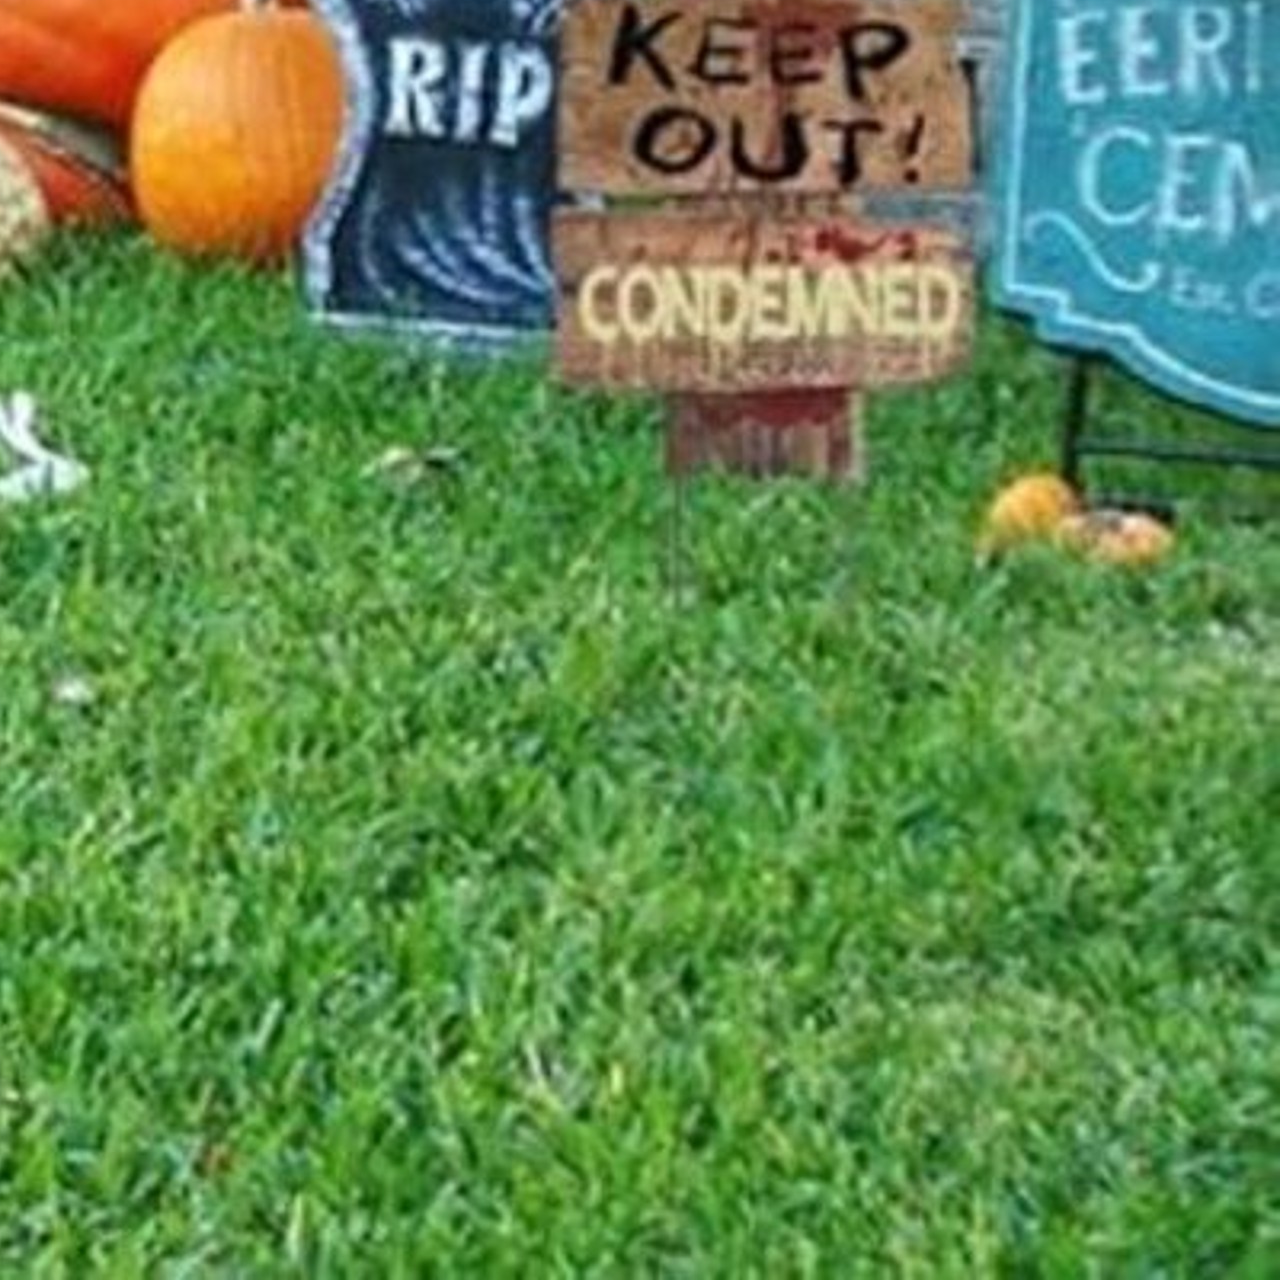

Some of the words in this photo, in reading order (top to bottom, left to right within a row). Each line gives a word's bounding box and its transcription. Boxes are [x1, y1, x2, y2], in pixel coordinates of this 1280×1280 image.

[382, 36, 552, 147] RIP
[606, 4, 909, 104] KEEP
[633, 107, 926, 184] OUT!
[578, 262, 959, 341] CONDEMNED
